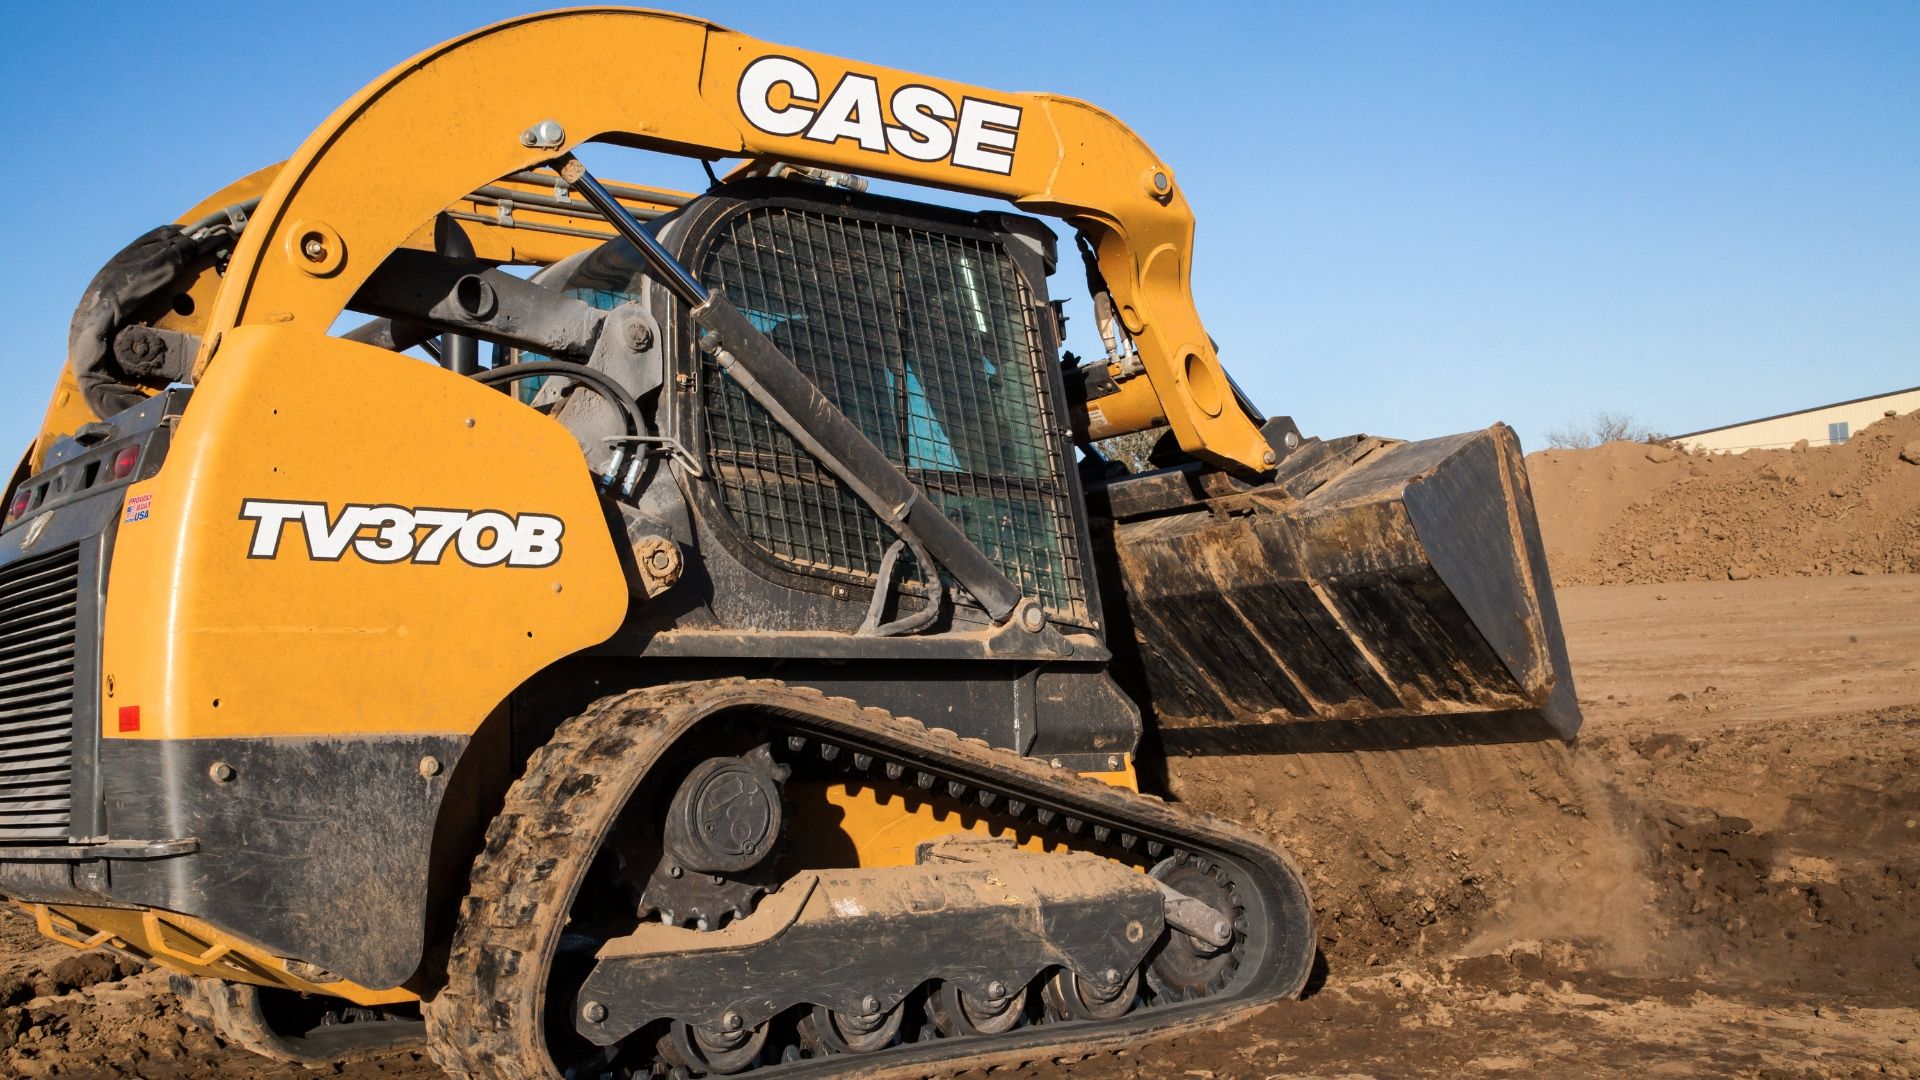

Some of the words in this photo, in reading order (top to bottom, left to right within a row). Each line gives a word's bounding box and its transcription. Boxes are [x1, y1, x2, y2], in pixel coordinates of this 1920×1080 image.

[737, 54, 1023, 177] CASE
[128, 494, 152, 504] PROUDLY
[136, 501, 152, 511] BUILT
[135, 510, 149, 521] USA
[238, 498, 566, 569] TV370B
